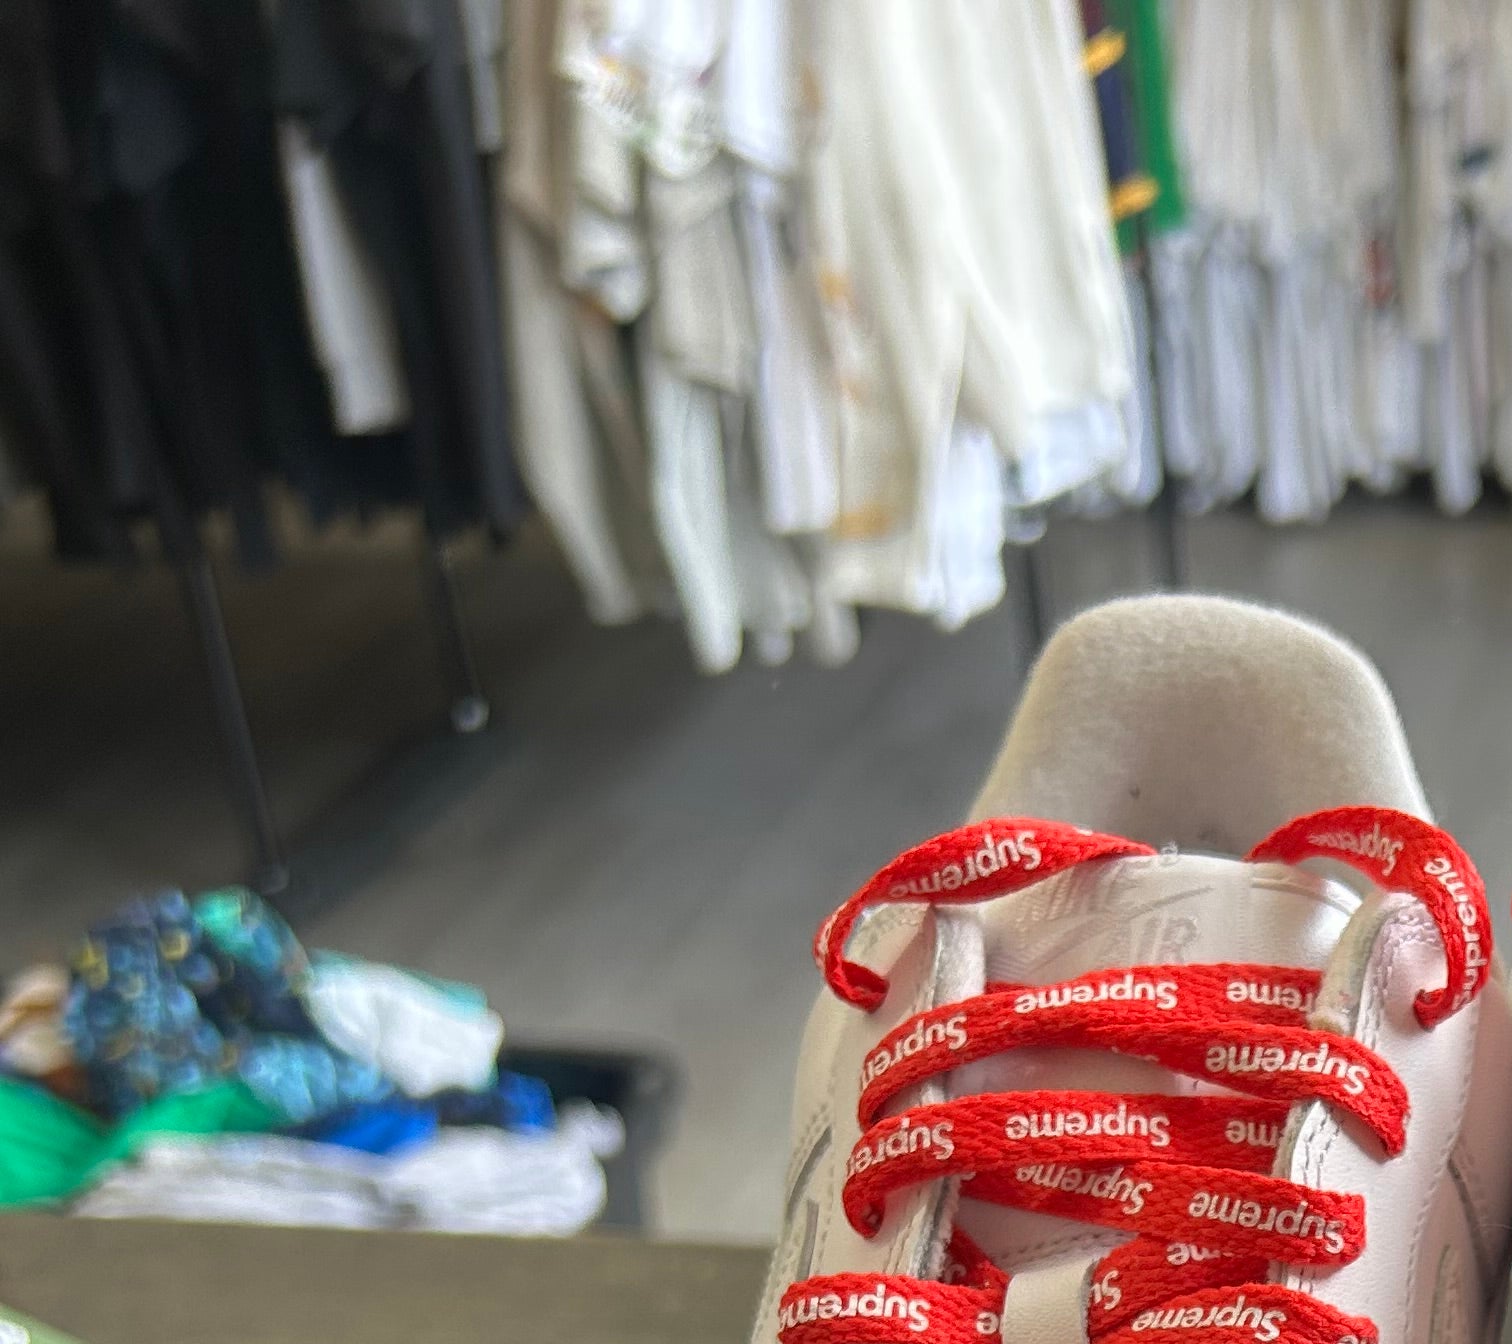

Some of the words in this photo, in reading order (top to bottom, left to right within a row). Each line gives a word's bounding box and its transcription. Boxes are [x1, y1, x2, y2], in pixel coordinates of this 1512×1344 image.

[888, 830, 1043, 899] Supreme
[1014, 972, 1179, 1011] Supreme
[1204, 1043, 1371, 1095] Supreme
[1005, 1104, 1171, 1147] Supreme
[1188, 1190, 1346, 1254] Supreme
[1131, 1296, 1287, 1342] Supreme
